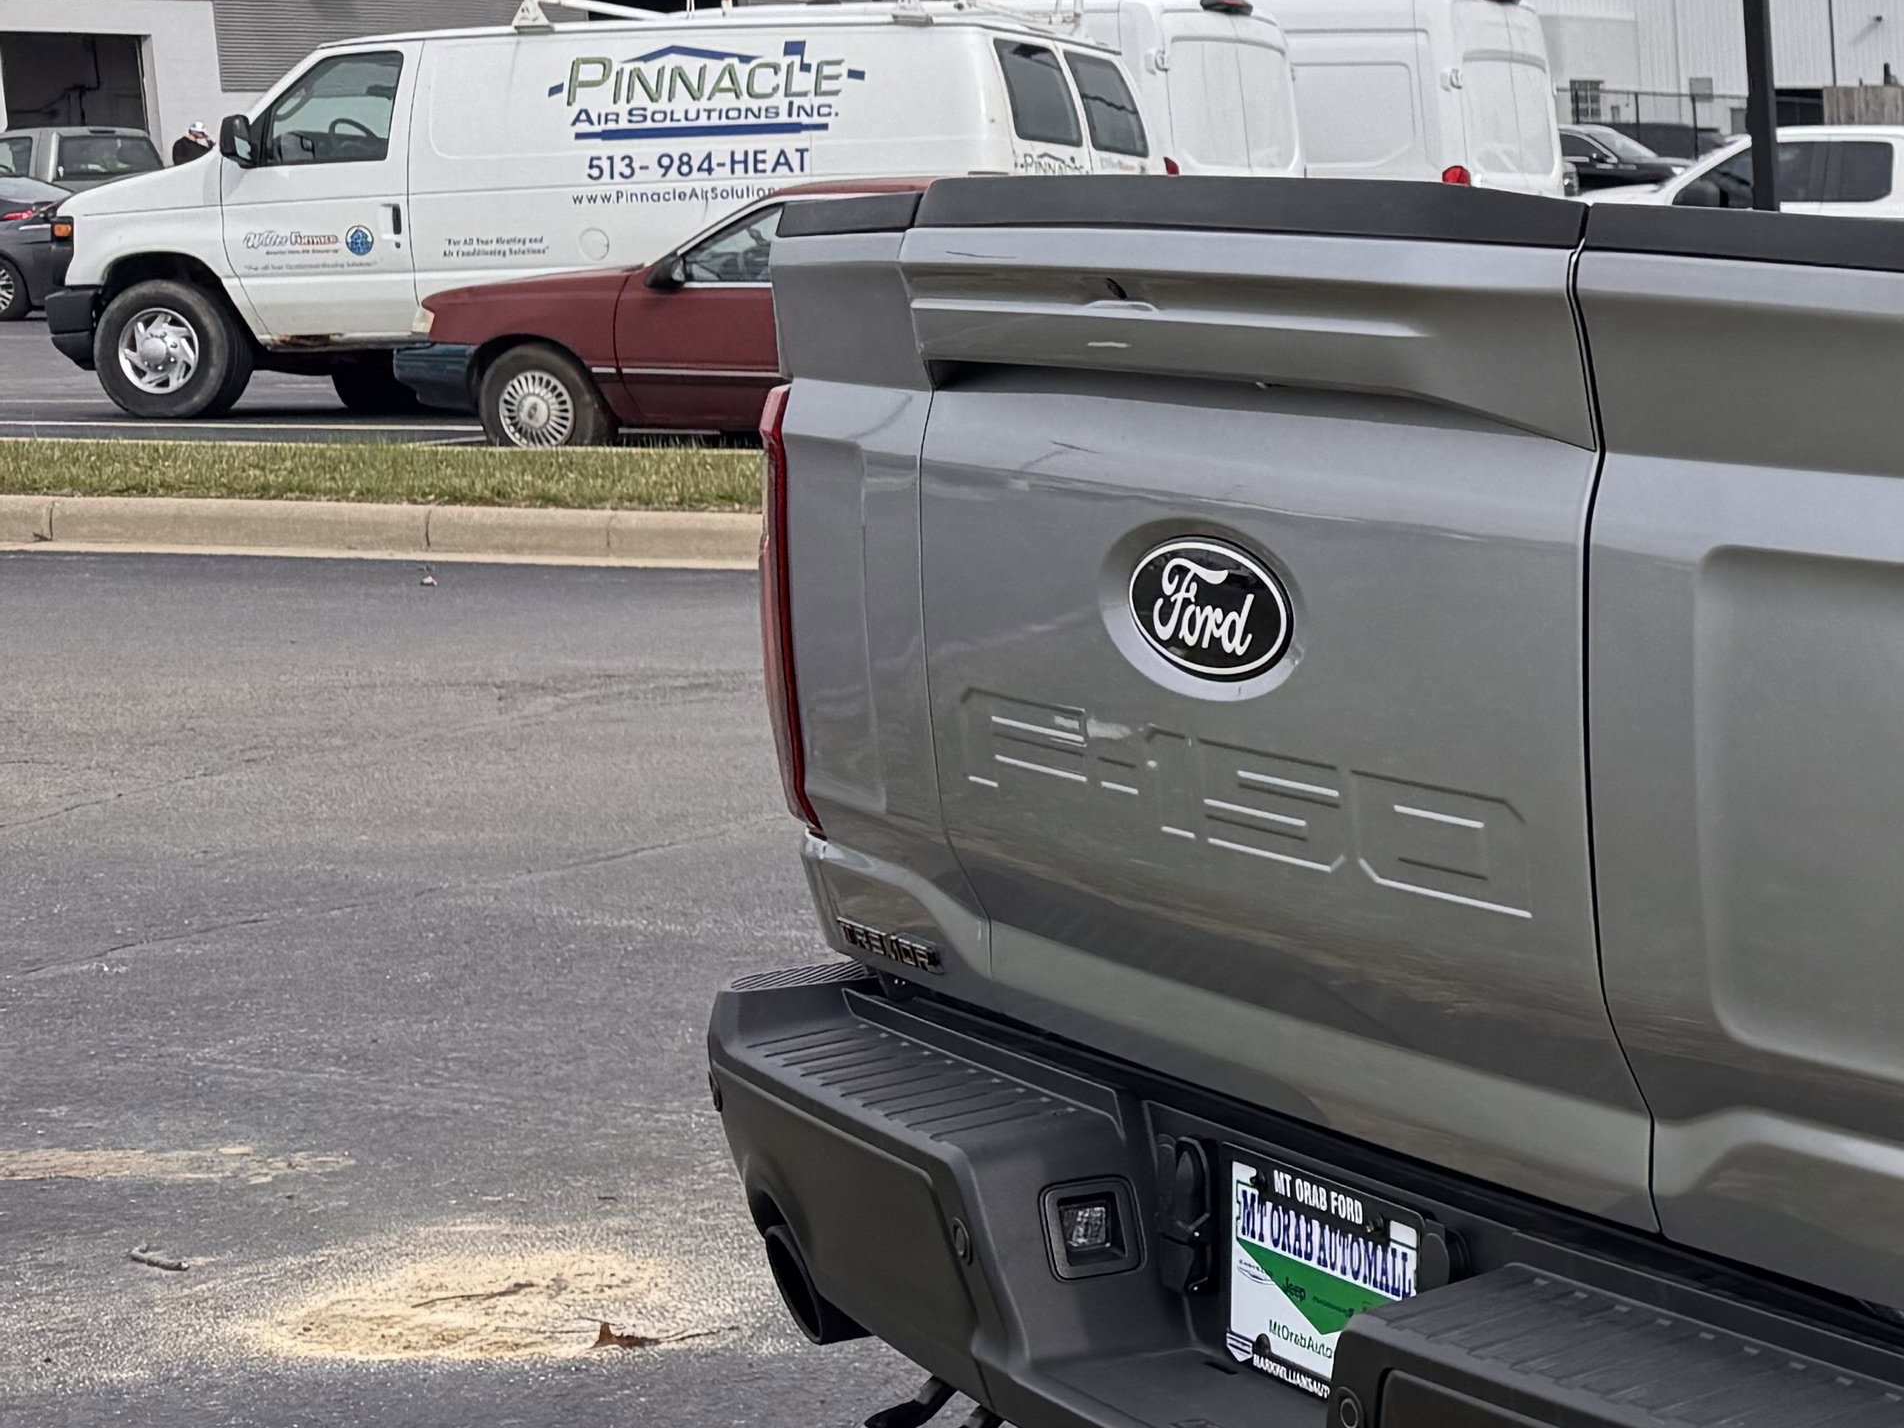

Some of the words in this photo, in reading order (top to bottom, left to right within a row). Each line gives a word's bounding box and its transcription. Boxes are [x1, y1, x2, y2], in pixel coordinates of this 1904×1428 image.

[566, 56, 845, 107] PINNACLE
[1148, 554, 1258, 659] Ford
[837, 917, 938, 973] TREMOR
[1273, 1169, 1292, 1198] MT
[1295, 1178, 1328, 1212] ORAB
[1330, 1190, 1363, 1225] FORD
